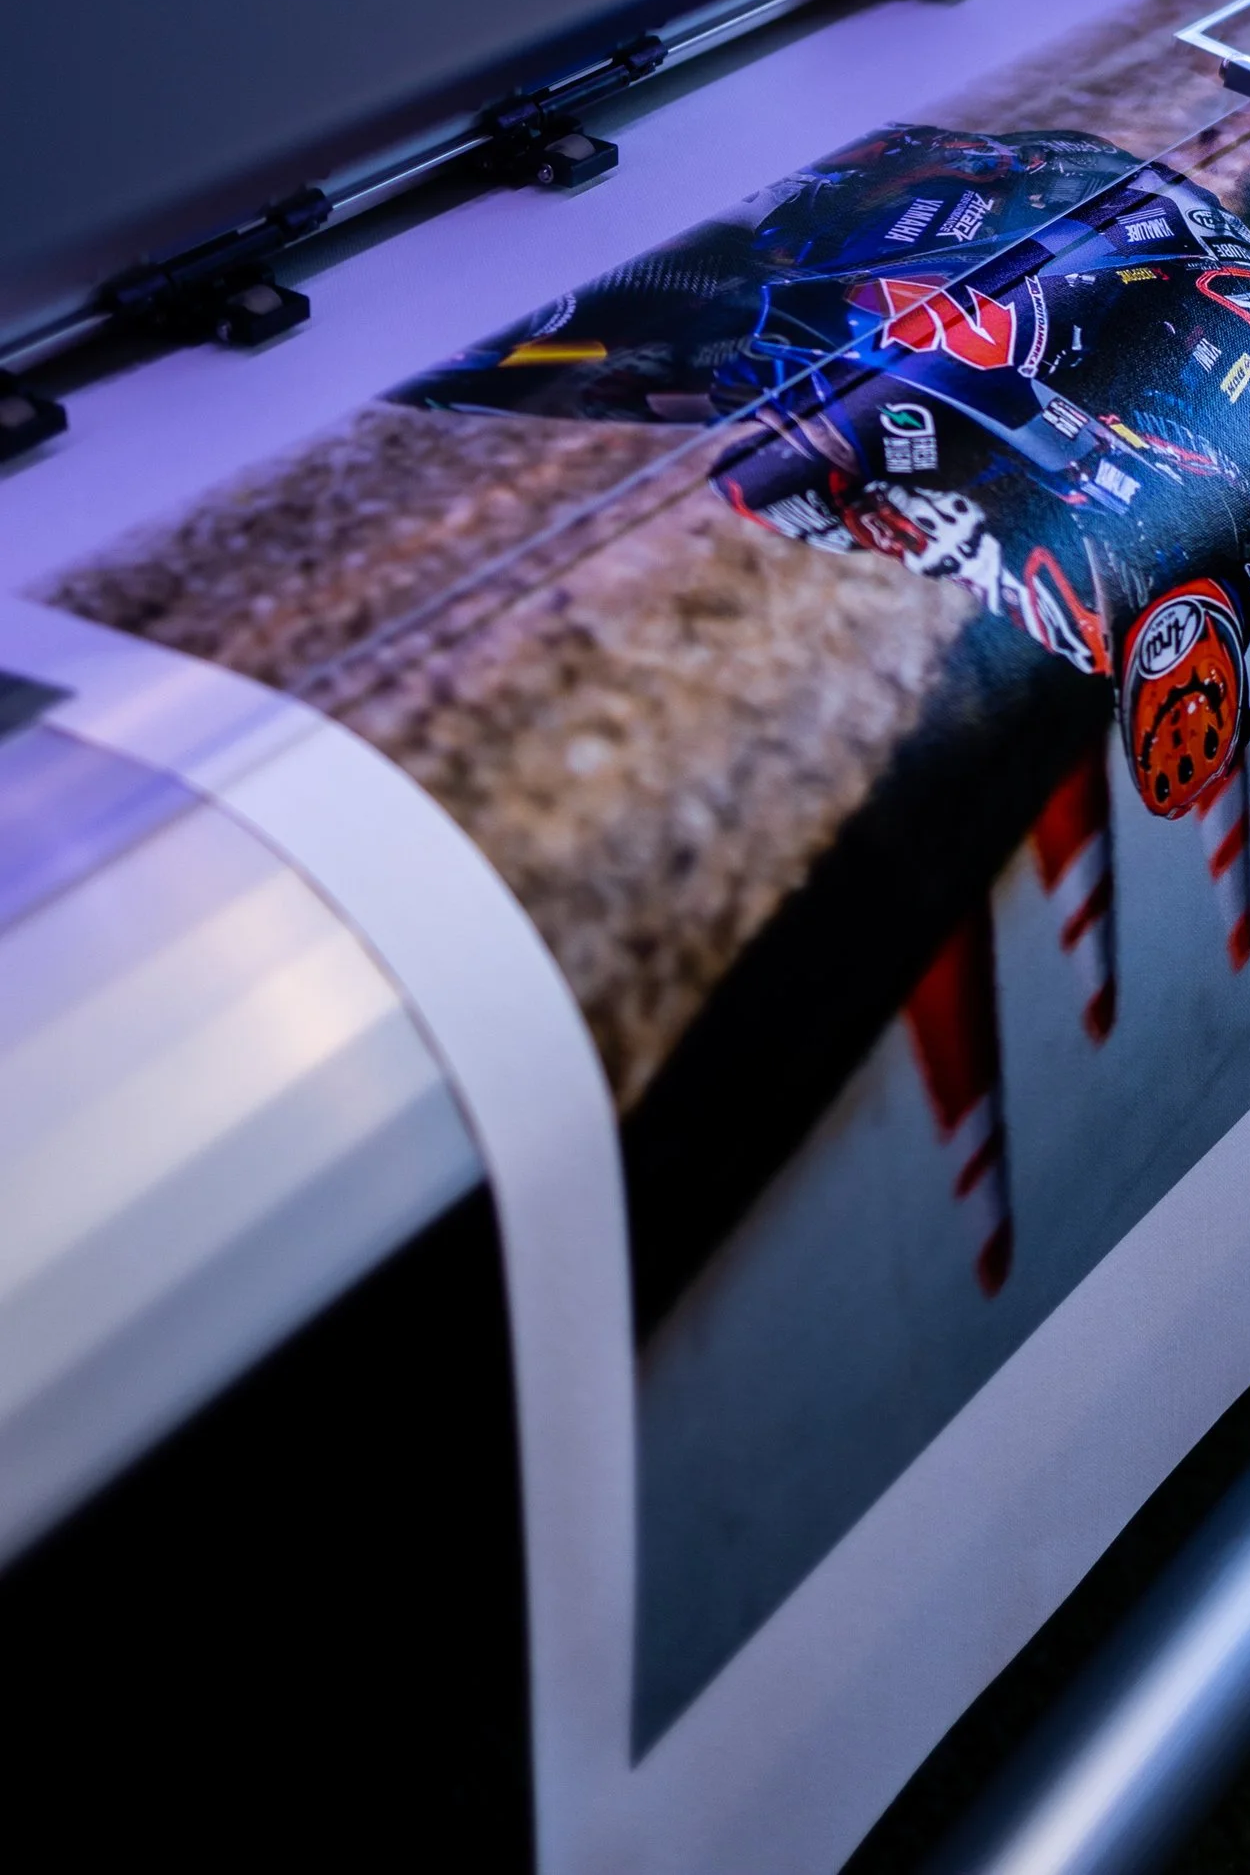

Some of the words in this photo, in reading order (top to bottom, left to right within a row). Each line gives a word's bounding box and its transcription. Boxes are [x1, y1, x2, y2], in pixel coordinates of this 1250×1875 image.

[884, 197, 944, 244] YAMAHA
[936, 192, 995, 242] Attack
[1126, 217, 1175, 243] YAMALUBE
